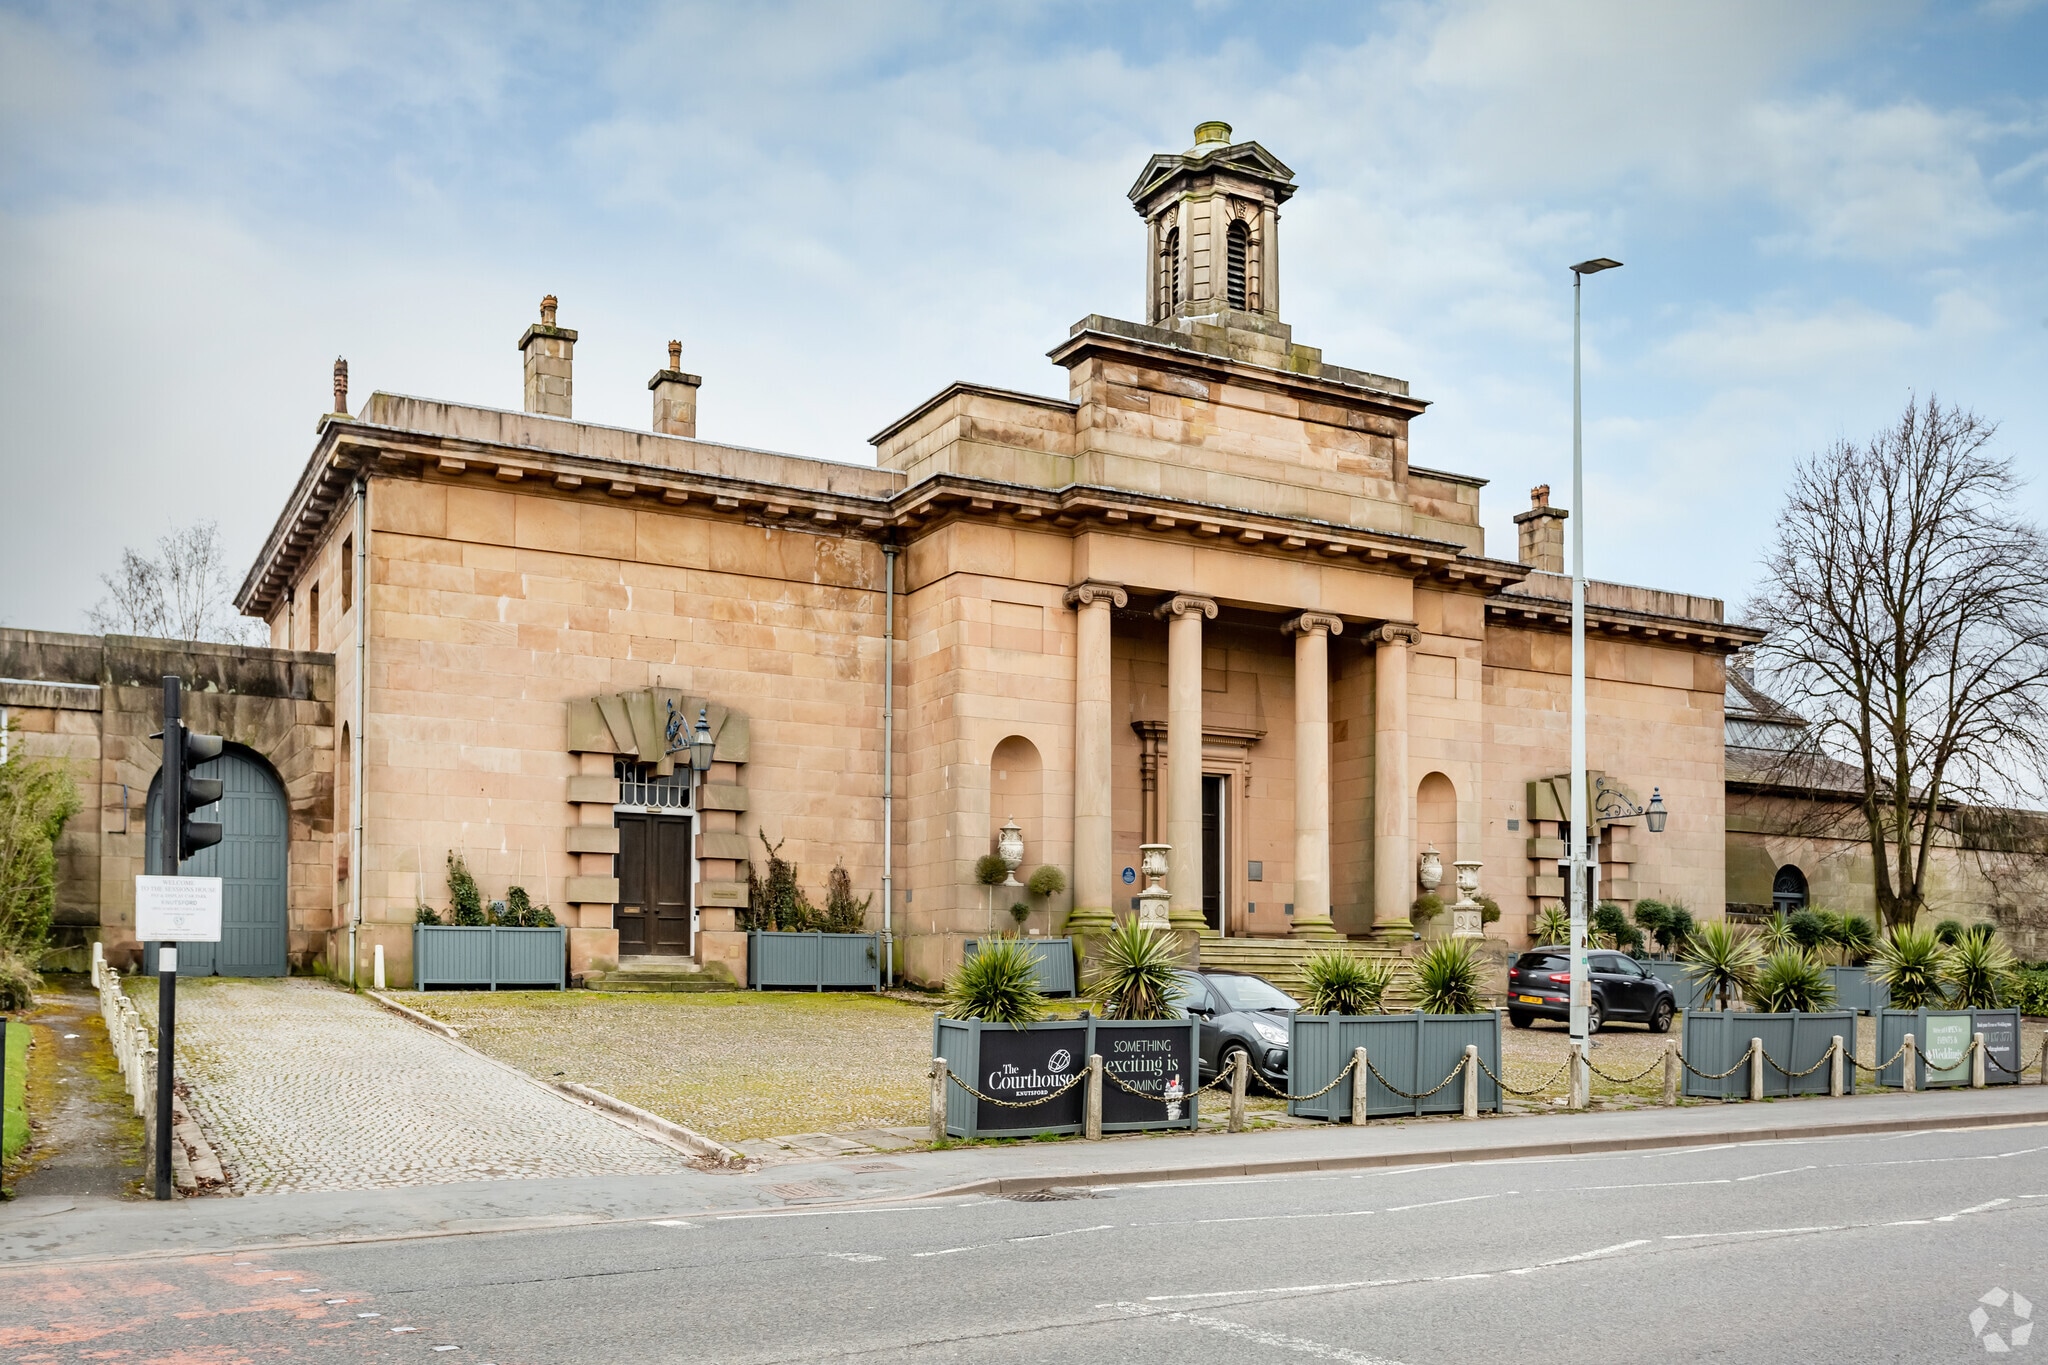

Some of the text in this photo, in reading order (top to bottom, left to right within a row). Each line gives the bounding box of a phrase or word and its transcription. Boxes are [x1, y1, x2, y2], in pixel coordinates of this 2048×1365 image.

[1114, 1039, 1172, 1053] SOMETHING
[1003, 1063, 1019, 1075] The
[1105, 1053, 1179, 1076] exciting is
[988, 1068, 1075, 1090] Courthouse
[1121, 1079, 1162, 1092] COMING
[1016, 1089, 1048, 1097] KNUTSFORD
